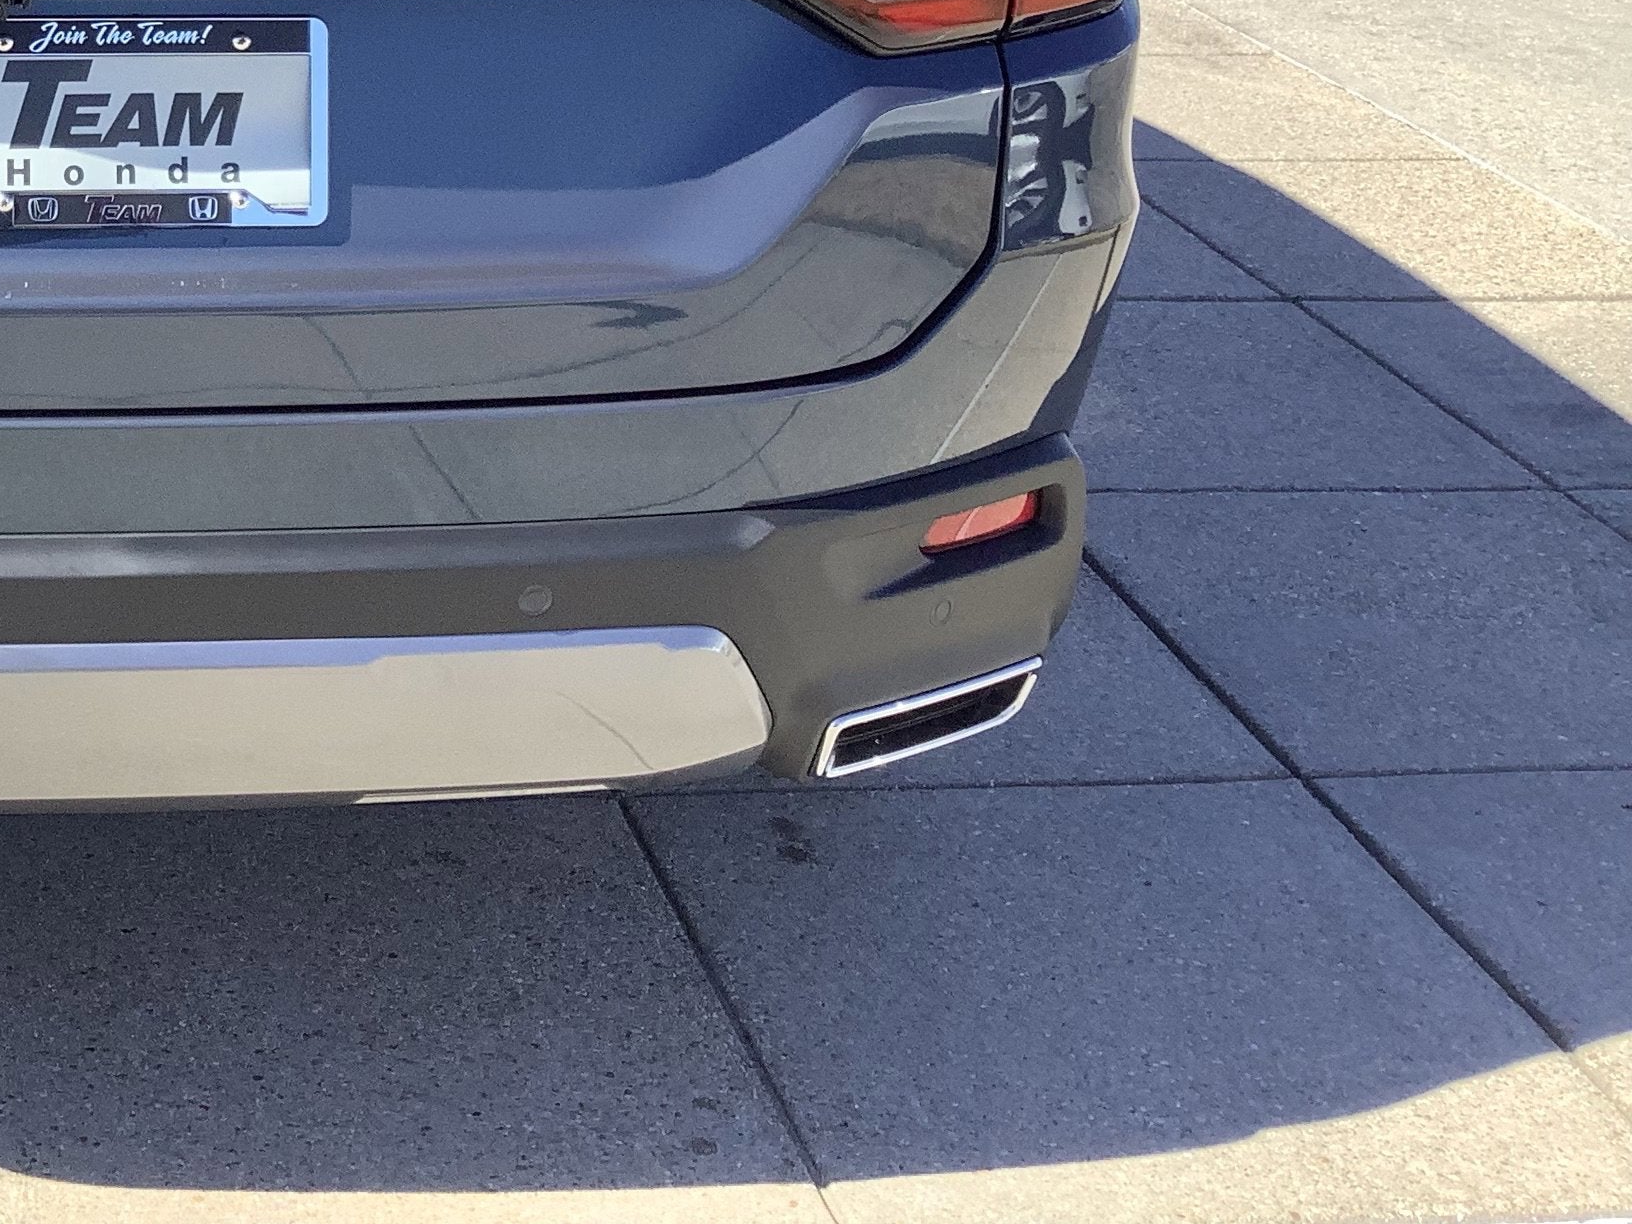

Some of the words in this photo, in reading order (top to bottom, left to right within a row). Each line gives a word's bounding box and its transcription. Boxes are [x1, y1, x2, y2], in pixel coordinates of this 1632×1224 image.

[29, 21, 88, 53] Join
[91, 21, 135, 46] The
[137, 21, 214, 46] Team!
[1, 59, 244, 150] TEAM
[6, 156, 242, 187] Honda
[84, 194, 163, 224] TEAM
